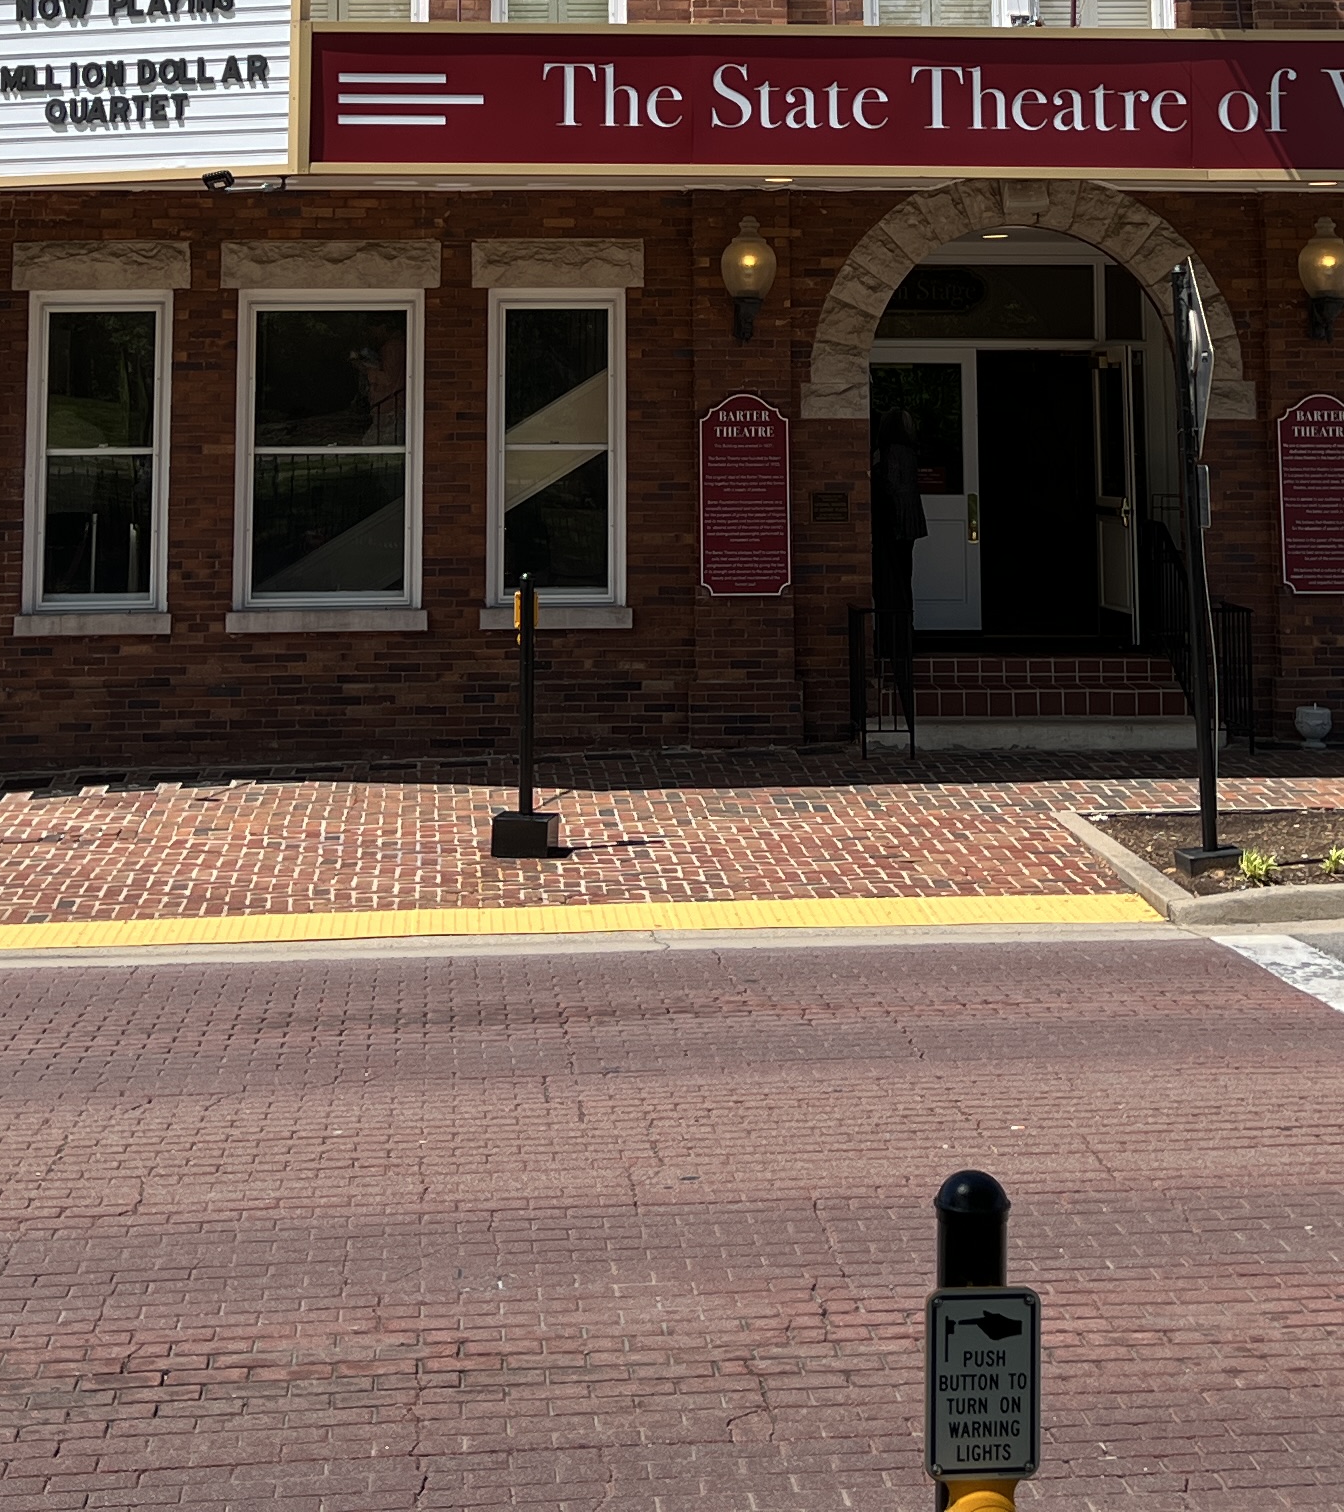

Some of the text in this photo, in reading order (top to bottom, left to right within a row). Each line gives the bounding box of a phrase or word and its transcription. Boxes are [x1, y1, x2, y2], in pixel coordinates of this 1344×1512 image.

[0, 53, 270, 94] MILLION DOLLAR
[542, 63, 684, 128] The
[710, 62, 890, 130] State
[910, 65, 1189, 133] Theatre
[1217, 67, 1298, 134] of
[45, 92, 189, 125] QUARTET
[916, 278, 976, 307] Stage
[718, 410, 771, 422] BARTER
[713, 426, 775, 438] THEATRE
[963, 1349, 1006, 1367] PUSH
[939, 1372, 1027, 1392] BUTTON TO
[946, 1396, 1021, 1415] TURN ON
[948, 1420, 1020, 1439] WARNING
[957, 1444, 1011, 1462] LIGHTS
